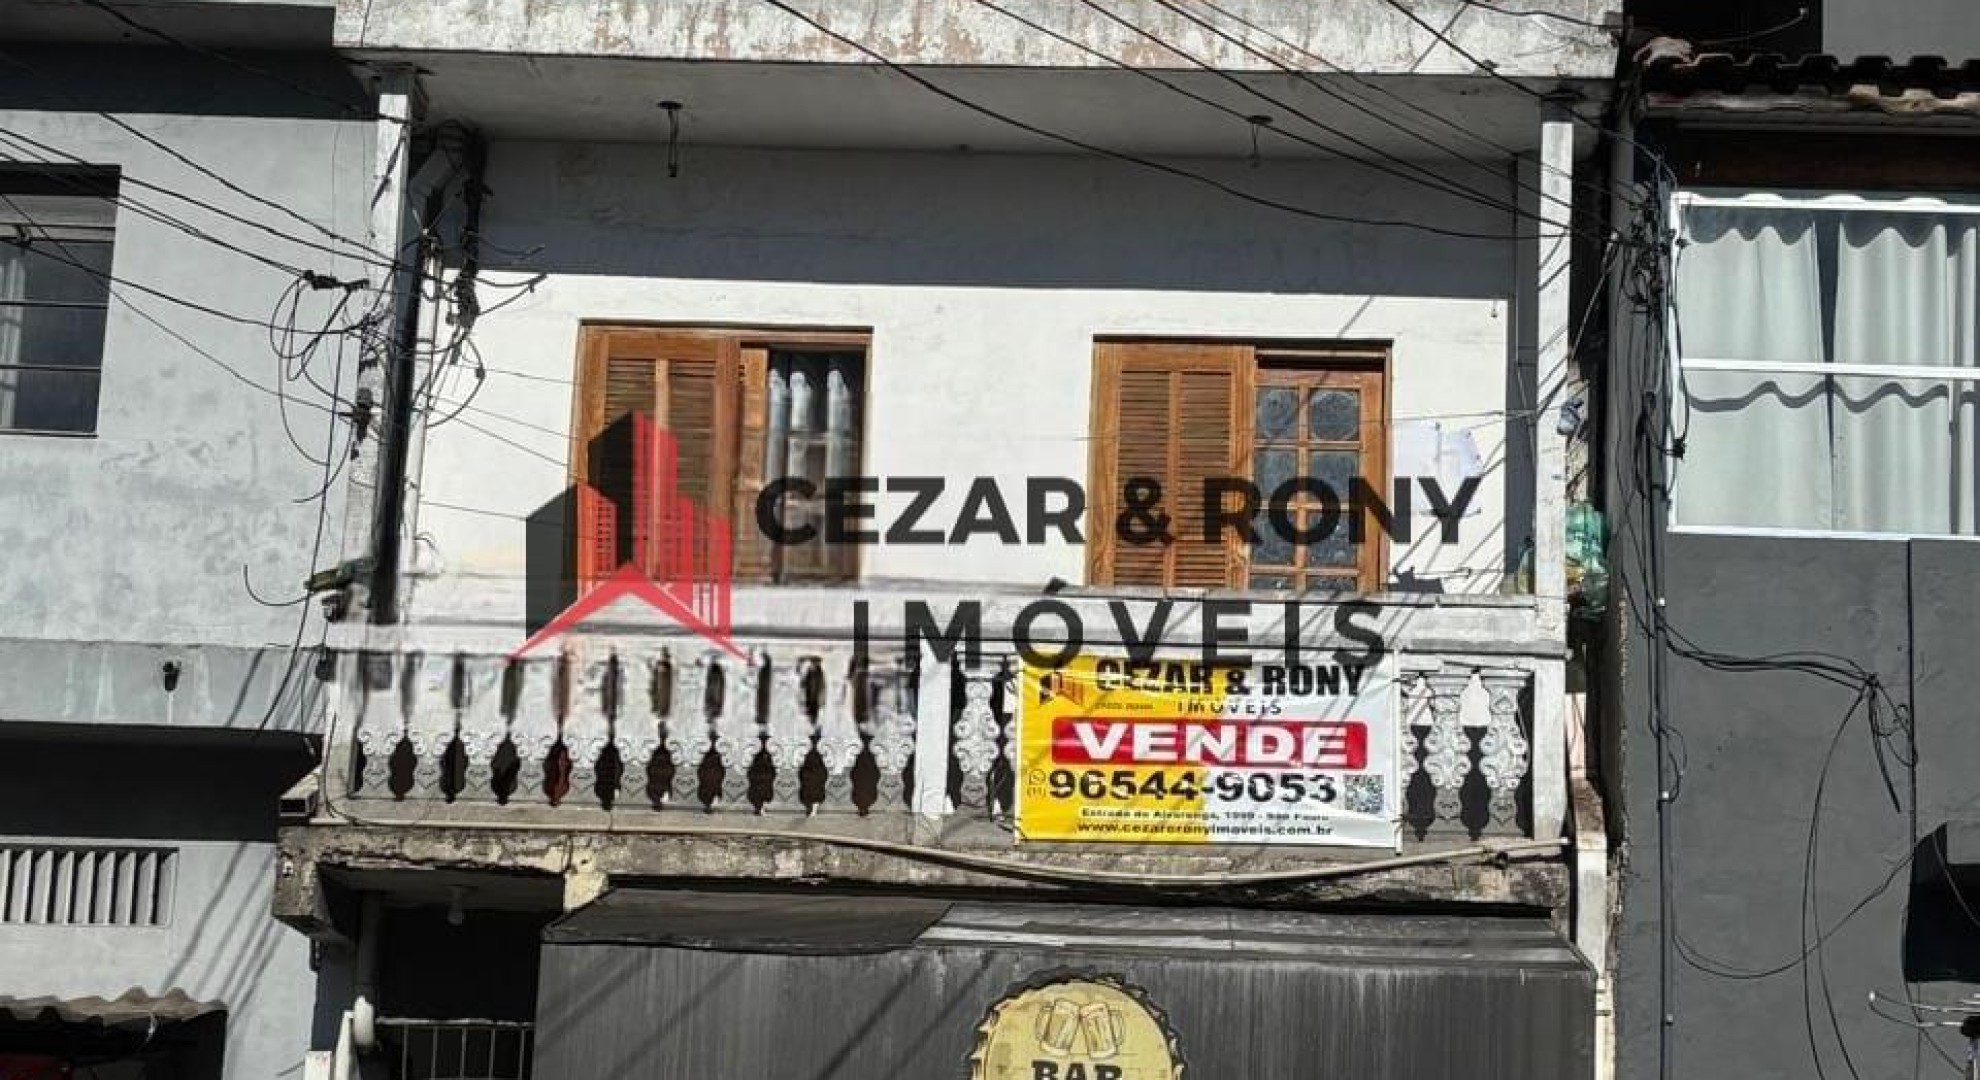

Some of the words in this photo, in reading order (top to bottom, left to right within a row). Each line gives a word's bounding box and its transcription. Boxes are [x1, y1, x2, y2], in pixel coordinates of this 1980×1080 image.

[1097, 657, 1214, 695] CEZAR
[1225, 669, 1250, 695] &
[1262, 664, 1366, 696] RONY
[1073, 722, 1349, 765] VENDE
[1048, 769, 1338, 803] 96544-9053
[1031, 1060, 1123, 1080] BAR
